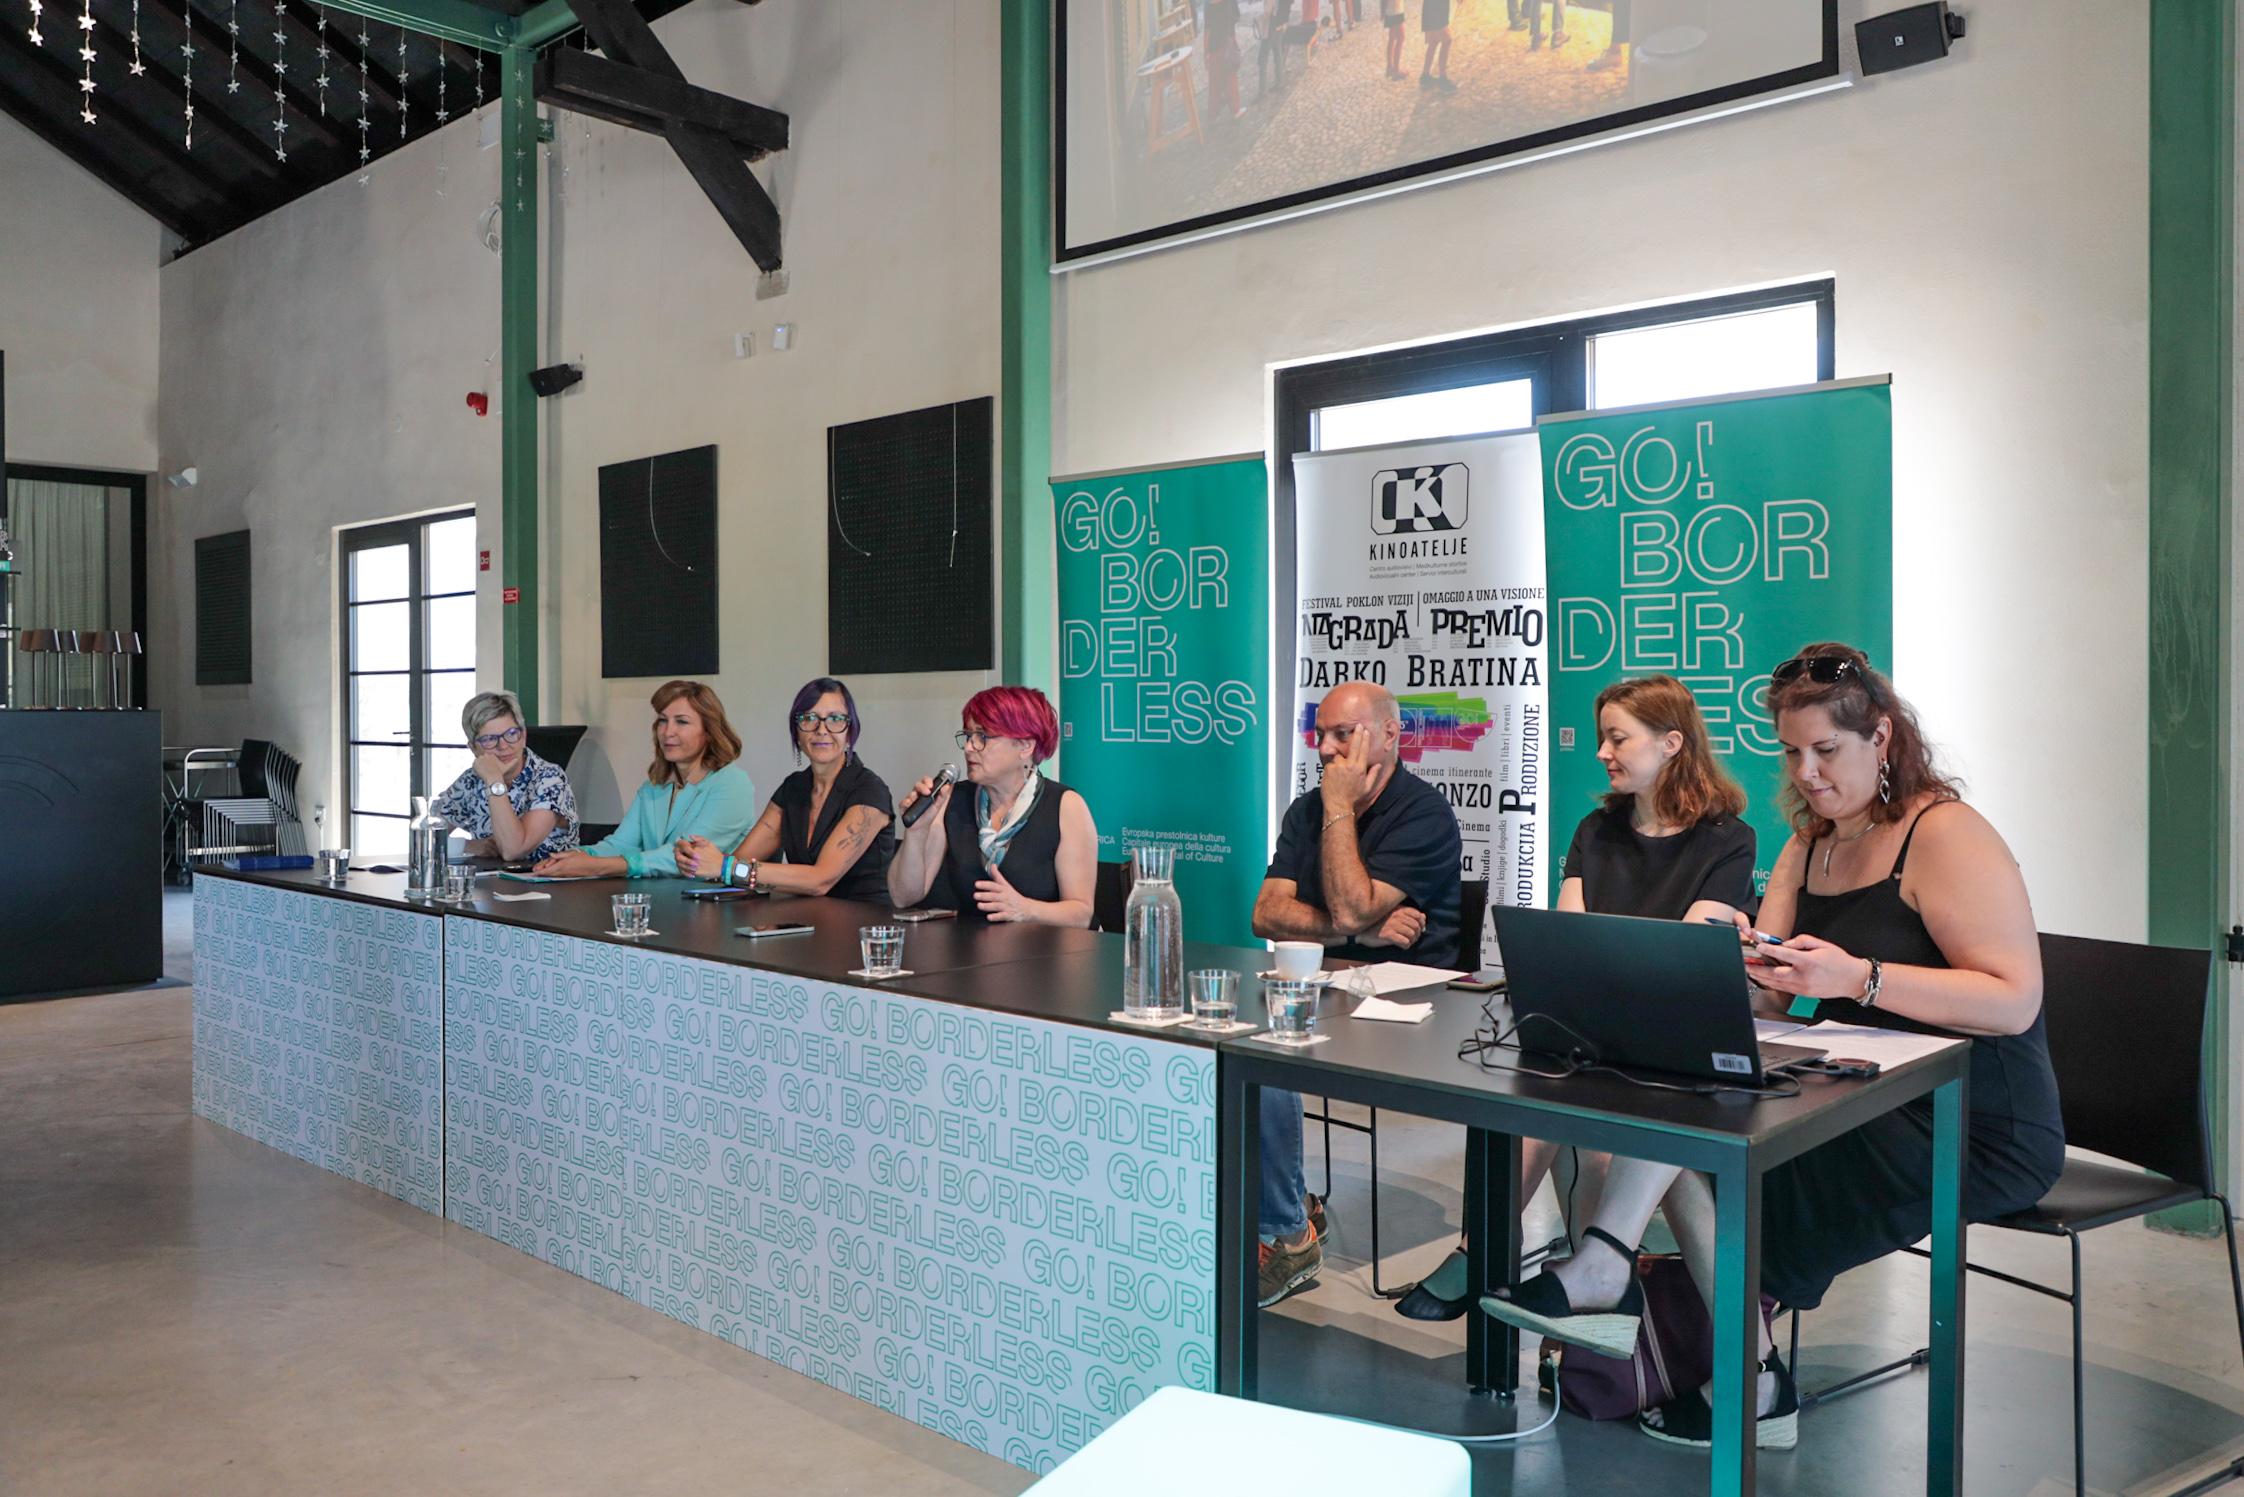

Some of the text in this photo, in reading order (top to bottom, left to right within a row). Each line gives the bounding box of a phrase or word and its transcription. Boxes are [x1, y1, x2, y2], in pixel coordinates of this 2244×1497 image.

[1555, 421, 1714, 510] GO!
[1061, 484, 1160, 552] GO!
[1369, 537, 1468, 561] KINOATELJE
[1620, 499, 1830, 588] BOR
[1101, 545, 1229, 612] BOR
[1302, 594, 1413, 609] FESTIVAL POKLON VIZIJI
[1422, 587, 1545, 604] OMAGGIO A UNA VISIONE
[1063, 616, 1177, 678] DER
[1302, 610, 1410, 650] NAGRADA
[1430, 605, 1543, 649] PREMIO
[1558, 591, 1744, 671] DER
[1300, 654, 1541, 688] DARKO BRATINA
[1101, 680, 1258, 745] LESS
[1504, 704, 1512, 732] eventi
[1412, 766, 1444, 777] cinema
[1122, 827, 1226, 843] Evropska prestolnica kulture
[1184, 841, 1201, 851] della
[1202, 843, 1232, 853] cultura
[1185, 852, 1194, 861] of
[1195, 852, 1224, 863] Culture
[235, 913, 327, 959] BORDERLESS
[333, 933, 362, 967] GO!
[281, 892, 307, 923] GO!
[310, 897, 417, 946] BORDERLESS
[445, 915, 623, 980] GO! BORDERLESS
[263, 948, 287, 980] GO!
[289, 954, 393, 1007] BORDERLESS
[400, 980, 431, 1017] GO!
[302, 988, 329, 1023] GO!
[510, 963, 547, 1002] GO!
[444, 984, 578, 1048] BORDERLESS
[625, 953, 808, 1025] BORDERLESS
[820, 988, 877, 1039] GO!
[886, 1000, 1151, 1094] BORDERLESS
[262, 1008, 361, 1067] BORDERLESS
[368, 1040, 397, 1078] GO!
[401, 1049, 440, 1092] BOR
[483, 1029, 518, 1069] GO!
[665, 1001, 711, 1048] GO!
[718, 1012, 927, 1098] BORDERLESS
[941, 1058, 1007, 1116] GO!
[284, 1076, 389, 1142] BORDERLESS
[393, 1115, 424, 1155] GO!
[313, 1056, 422, 1121] BORDERLESS
[541, 1082, 579, 1126] GO!
[446, 1090, 623, 1181] GO! BORDERLESS
[778, 1069, 833, 1121] GO!
[840, 1084, 1089, 1188] BORDERLESS
[1106, 1147, 1187, 1213] GO!
[476, 1171, 510, 1216] GO!
[515, 1149, 552, 1195] GO!
[662, 1084, 855, 1176] BORDERLESS
[868, 1138, 928, 1197] GO!
[937, 1156, 1213, 1279] BORDERLESS
[633, 1159, 816, 1258] BORDERLESS
[827, 1222, 884, 1282] GO!
[893, 1244, 1161, 1378] BORDERLESS
[720, 1143, 770, 1197] GO!
[778, 1160, 1005, 1273] BORDERLESS
[1022, 1232, 1095, 1301] GO!
[1106, 1257, 1213, 1339] BOR
[668, 1253, 861, 1367] BORDERLESS
[873, 1332, 934, 1397] GO!
[767, 1247, 819, 1305] GO!
[828, 1268, 1072, 1400] BORDERLESS
